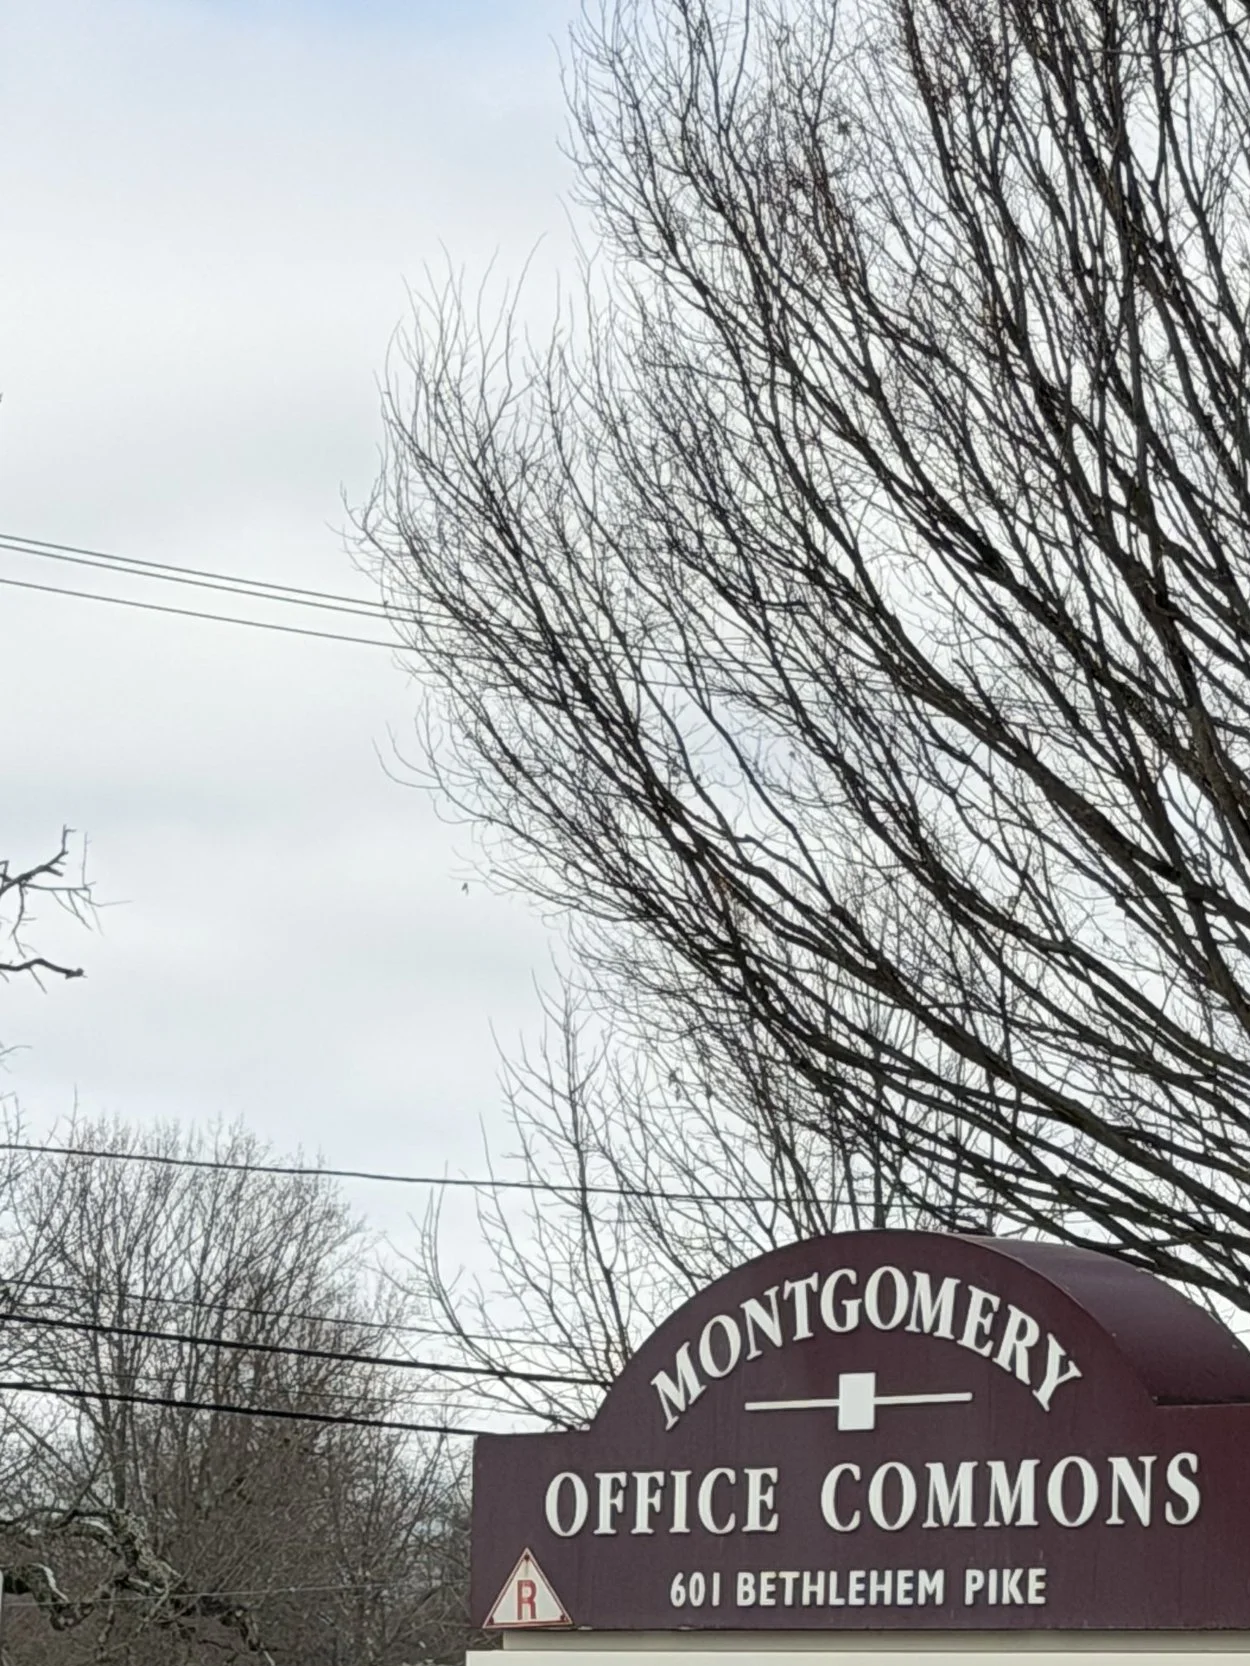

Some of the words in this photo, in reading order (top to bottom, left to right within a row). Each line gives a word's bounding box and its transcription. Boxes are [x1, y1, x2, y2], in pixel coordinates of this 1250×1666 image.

[651, 1265, 1081, 1431] MONTGOMERY
[544, 1467, 779, 1537] OFFICE
[821, 1452, 1202, 1531] COMMONS
[517, 1579, 537, 1621] R
[670, 1571, 720, 1608] 601
[736, 1569, 945, 1607] BETHLEHEM
[965, 1568, 1047, 1605] PIKE
